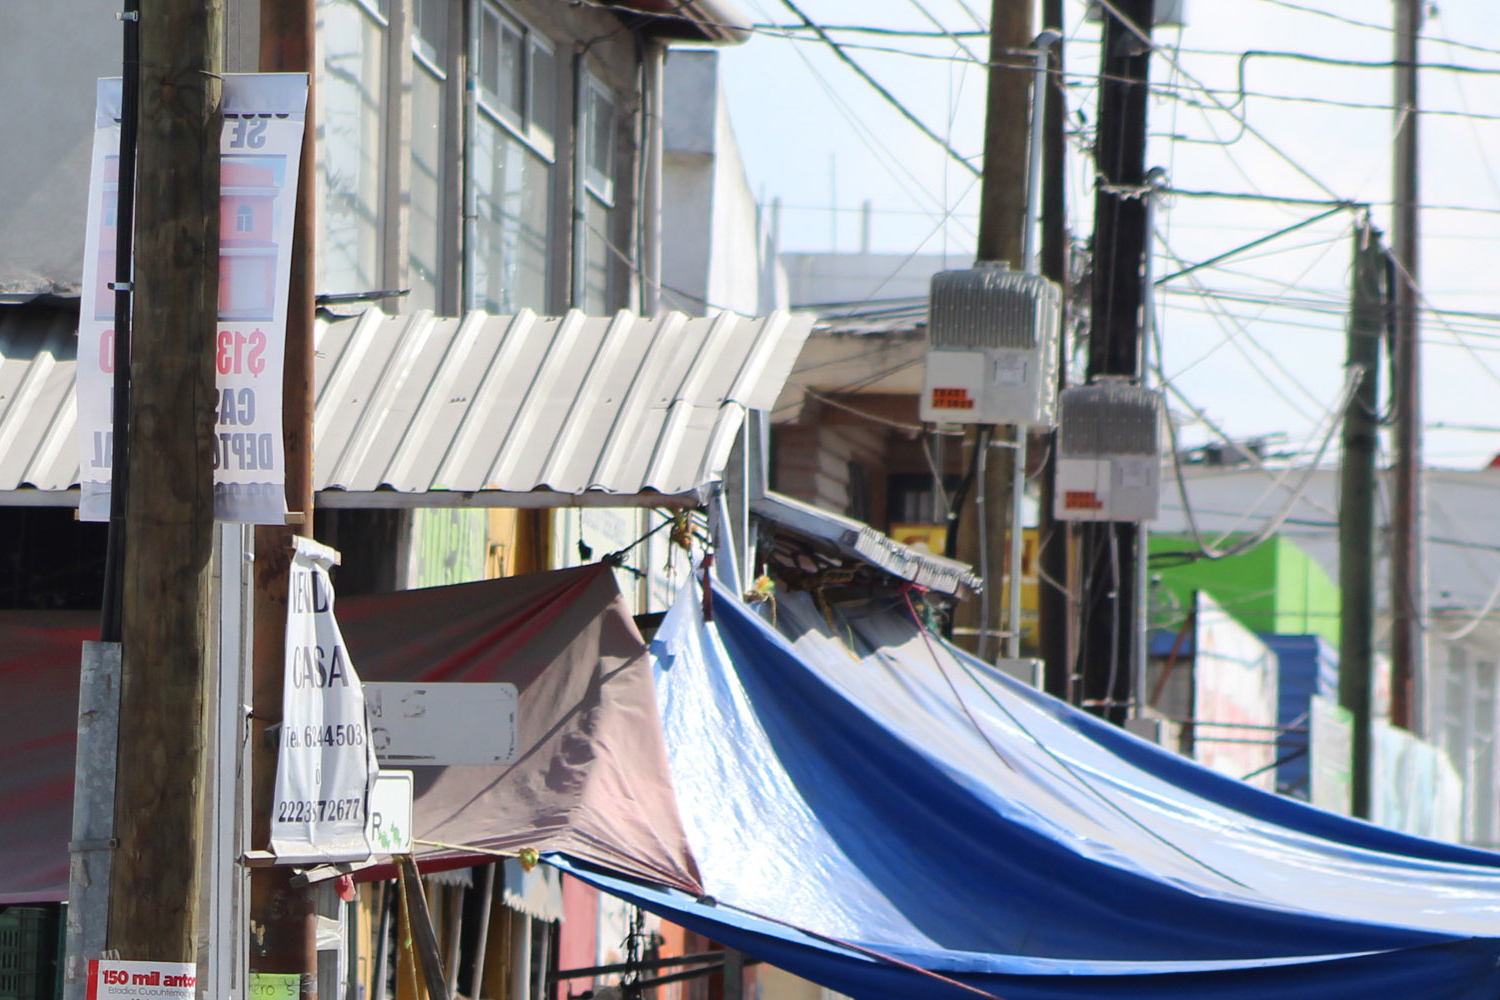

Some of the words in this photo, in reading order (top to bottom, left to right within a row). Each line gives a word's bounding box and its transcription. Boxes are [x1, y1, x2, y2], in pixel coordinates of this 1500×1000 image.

[293, 645, 350, 690] CASA
[102, 970, 129, 985] 150
[132, 971, 160, 986] mil
